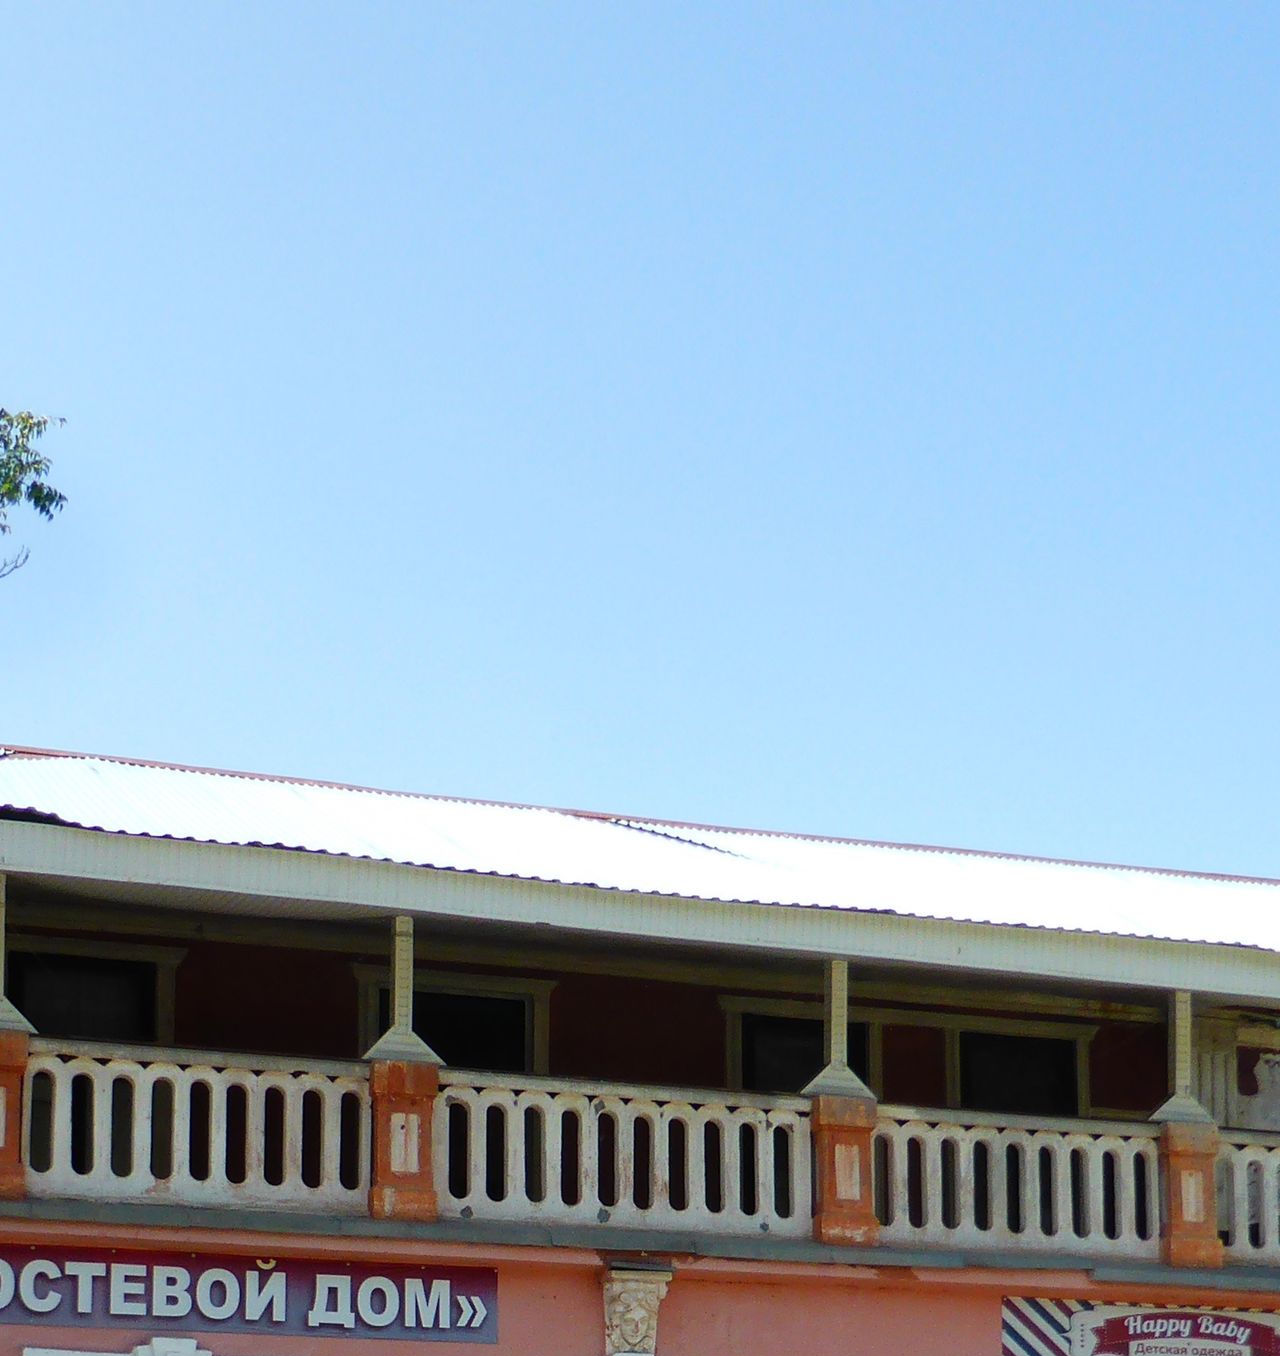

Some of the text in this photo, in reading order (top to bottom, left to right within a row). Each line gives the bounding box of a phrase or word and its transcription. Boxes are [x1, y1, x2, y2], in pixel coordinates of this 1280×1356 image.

[308, 1273, 488, 1329] ДОМ»
[1124, 1315, 1251, 1344] Happy Baby
[1134, 1343, 1187, 1356] Детская
